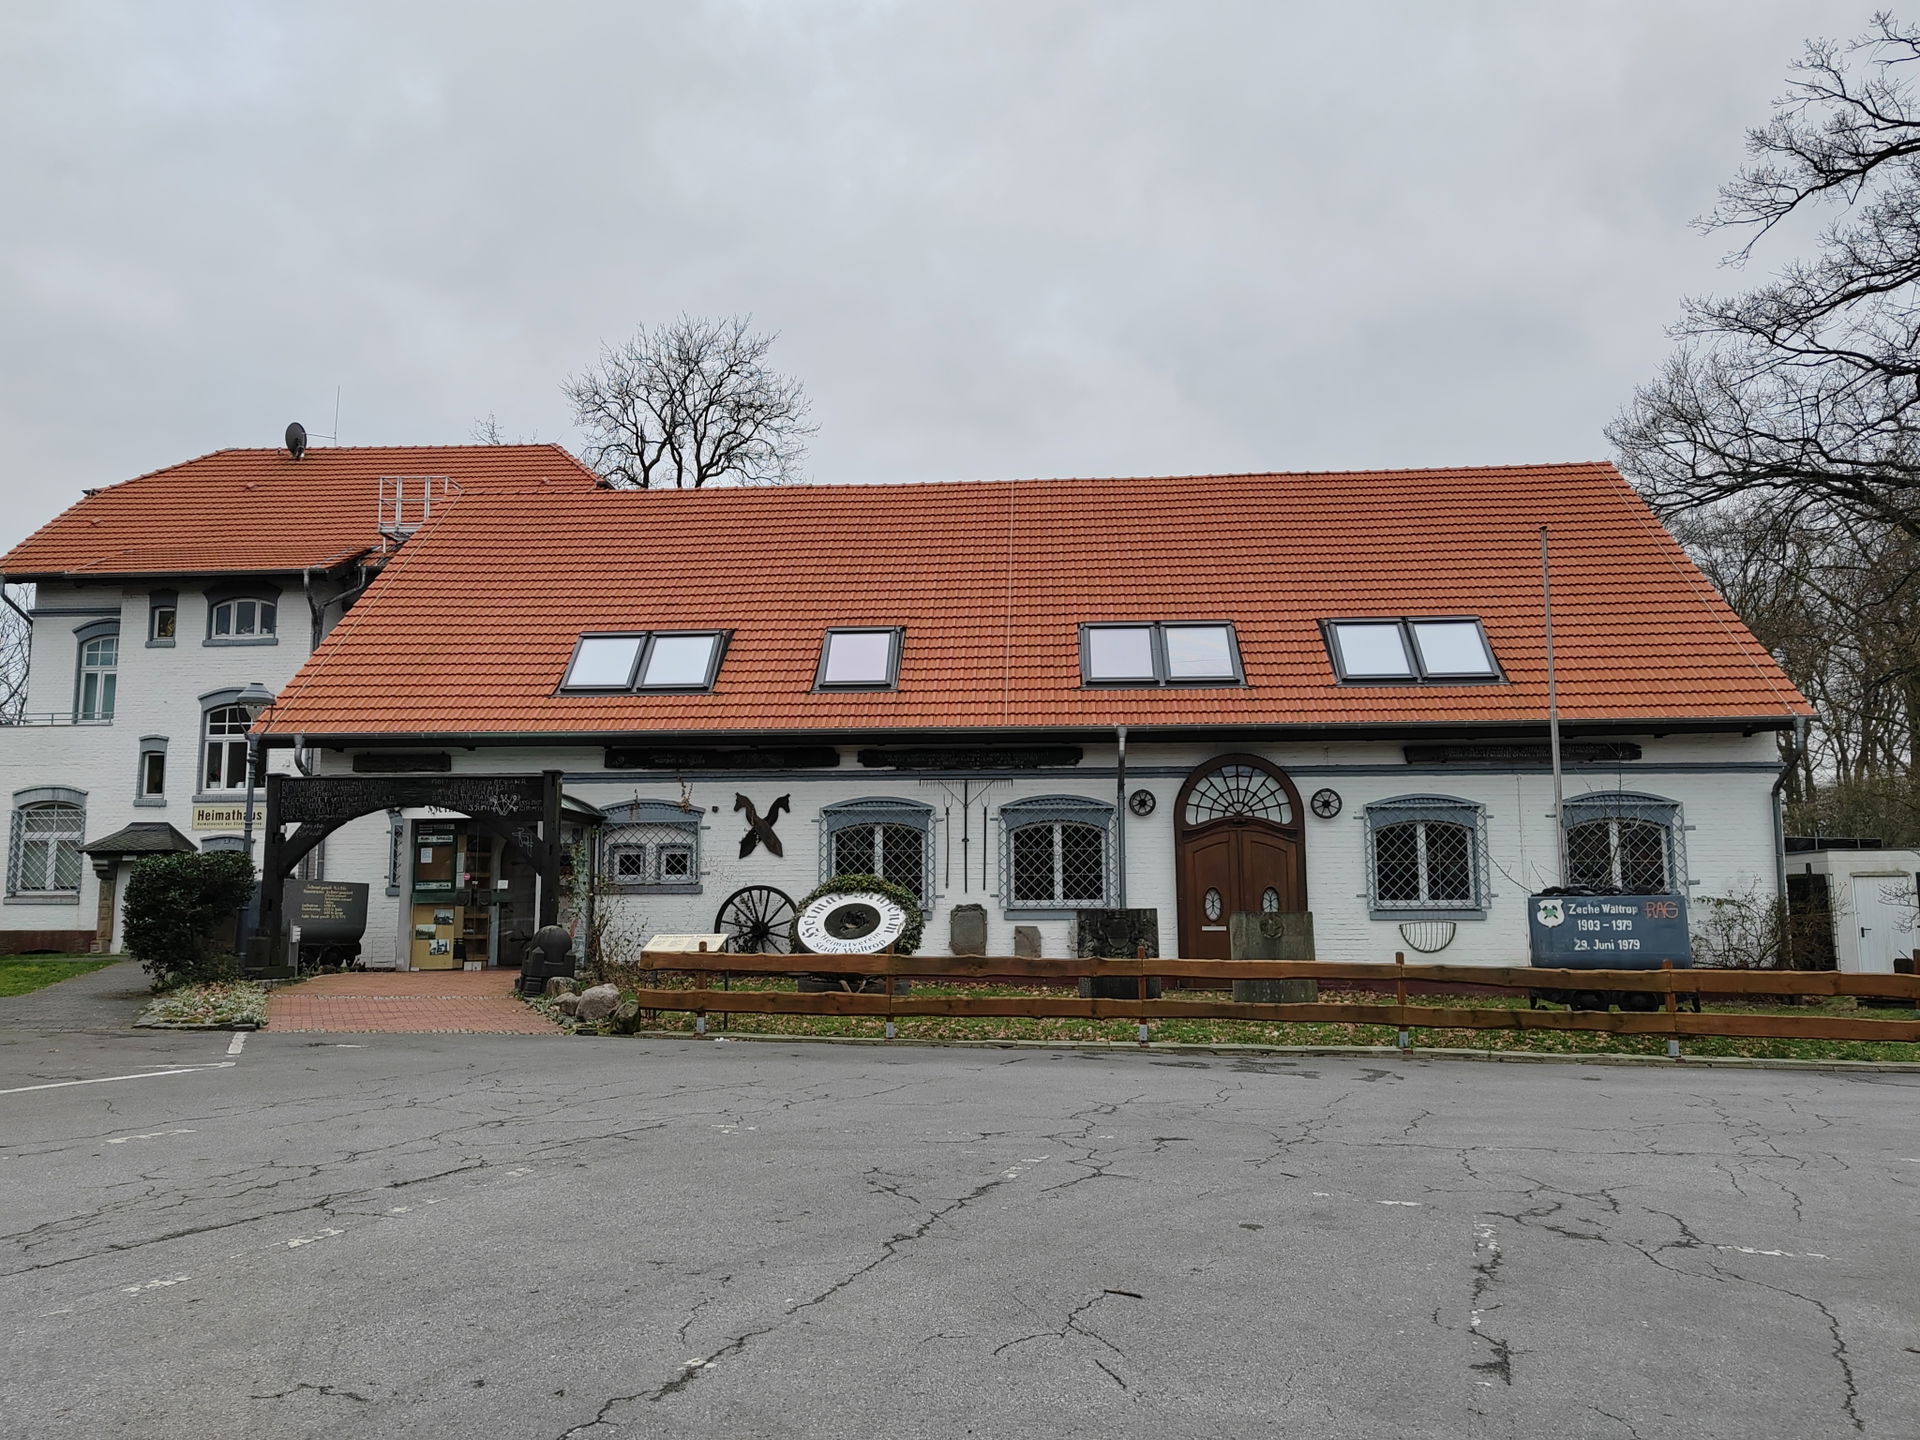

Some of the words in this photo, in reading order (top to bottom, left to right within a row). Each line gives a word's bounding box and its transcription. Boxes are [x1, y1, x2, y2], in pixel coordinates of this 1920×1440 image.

[1567, 903, 1600, 914] Zeche
[1601, 904, 1639, 915] Waltrop
[1643, 901, 1679, 918] RAG
[1577, 919, 1601, 931] 1903
[1611, 919, 1633, 931] 1979
[813, 941, 839, 954] Stadt
[843, 938, 887, 954] Waltrop
[820, 932, 882, 948] Heimatverein
[1573, 938, 1591, 951] 29.
[1593, 939, 1615, 951] Juni
[1617, 939, 1641, 951] 1979
